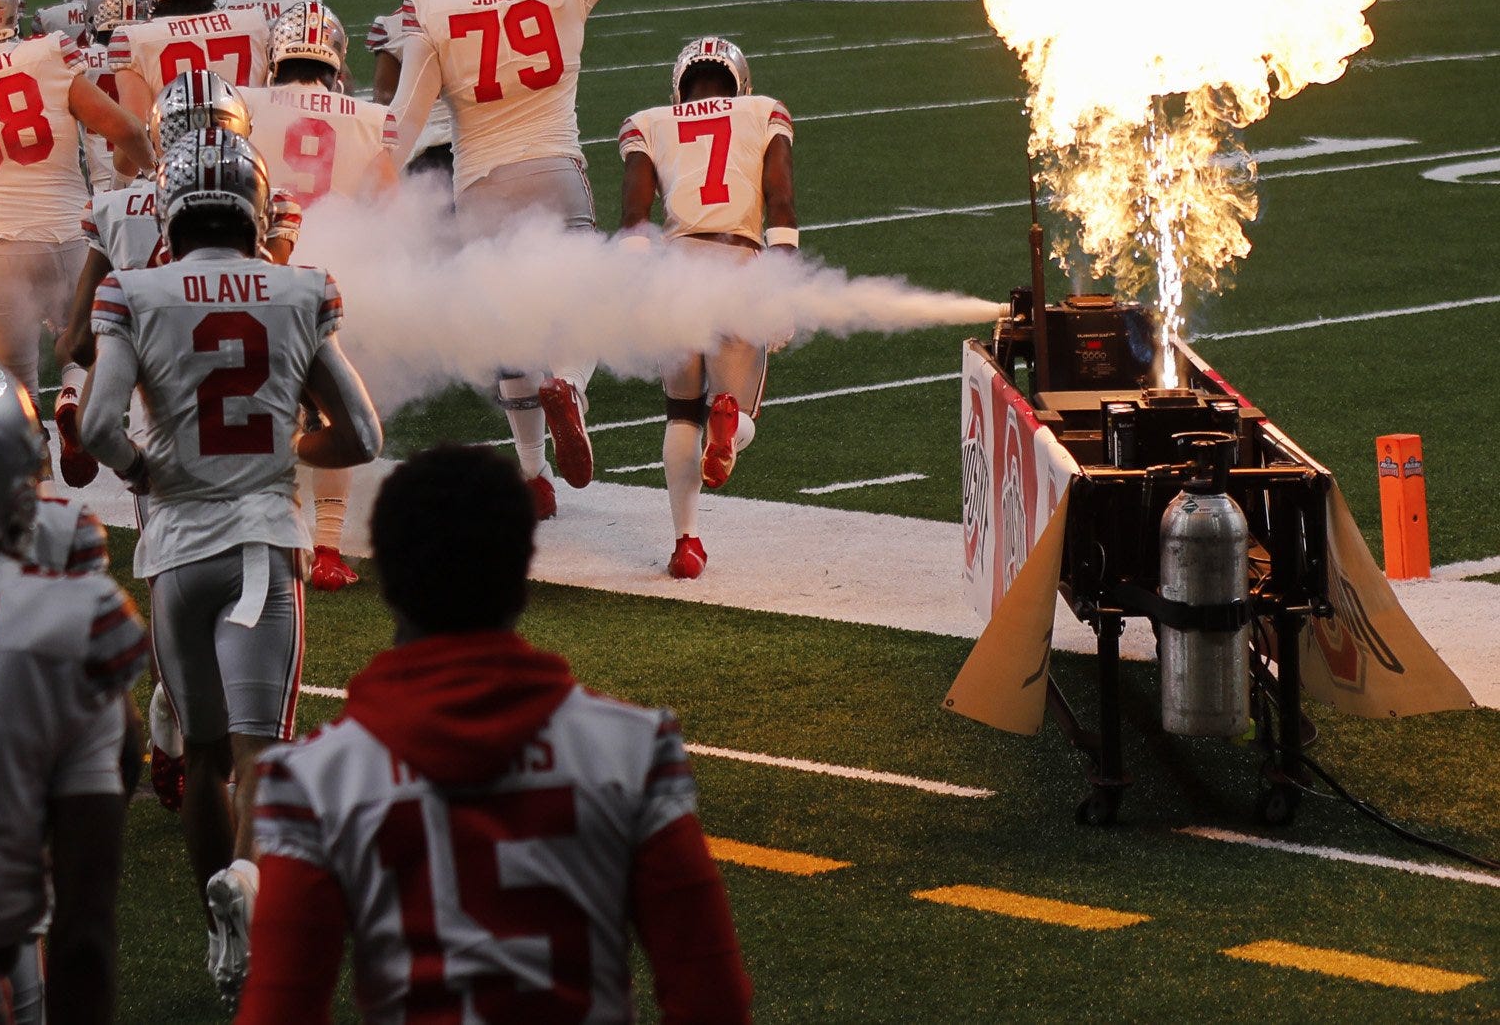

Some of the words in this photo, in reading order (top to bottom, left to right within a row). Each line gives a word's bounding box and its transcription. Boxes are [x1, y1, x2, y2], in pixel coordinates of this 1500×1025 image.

[168, 14, 232, 36] POTTER
[285, 46, 334, 59] EQUALITY
[271, 89, 332, 114] MILLER
[673, 97, 734, 117] BANKS
[283, 117, 336, 211] 9
[678, 116, 732, 206] 7
[182, 191, 238, 204] EQUALITY
[183, 274, 270, 303] OLAVE
[192, 311, 275, 457] 2
[374, 785, 593, 1025] 15
